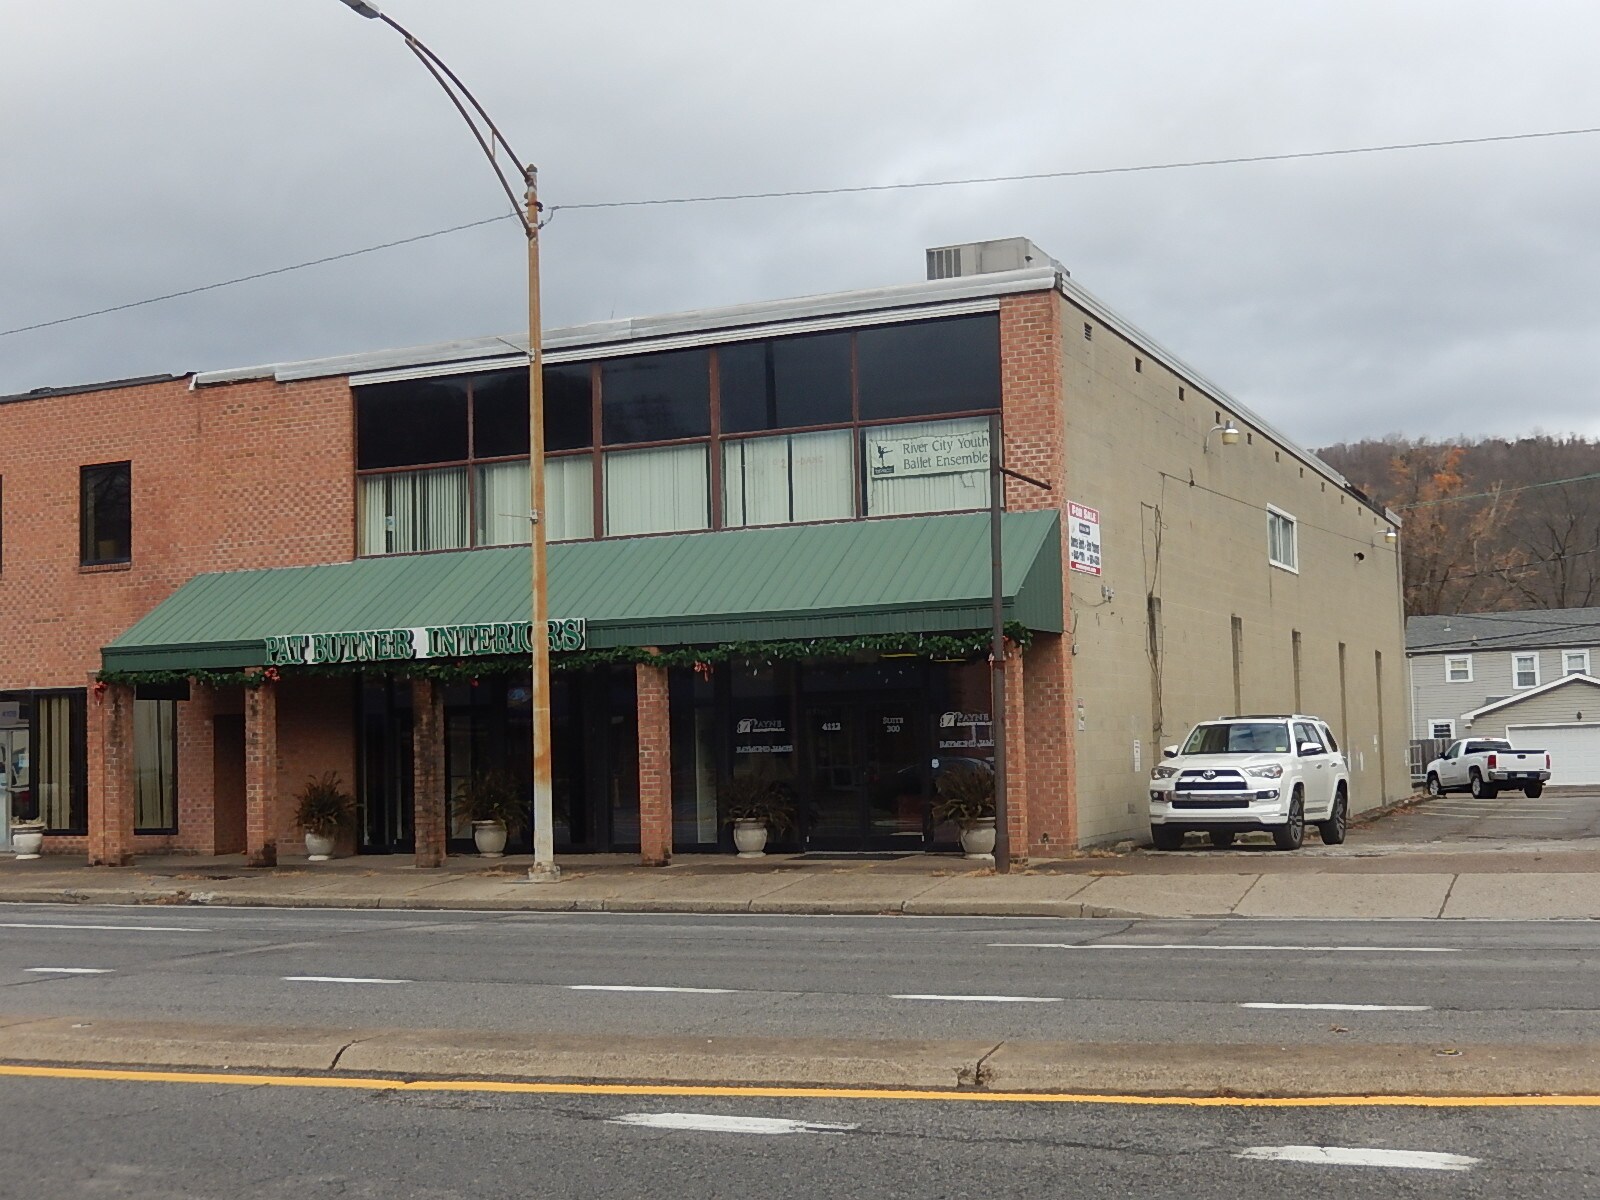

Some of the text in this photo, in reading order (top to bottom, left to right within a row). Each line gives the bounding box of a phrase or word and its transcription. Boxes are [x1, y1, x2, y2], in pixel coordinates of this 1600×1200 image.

[903, 434, 989, 454] River City Youth
[903, 456, 932, 470] Ballet
[936, 451, 989, 467] Ensemble
[264, 634, 307, 664] PAT
[311, 629, 414, 663] BUTNER
